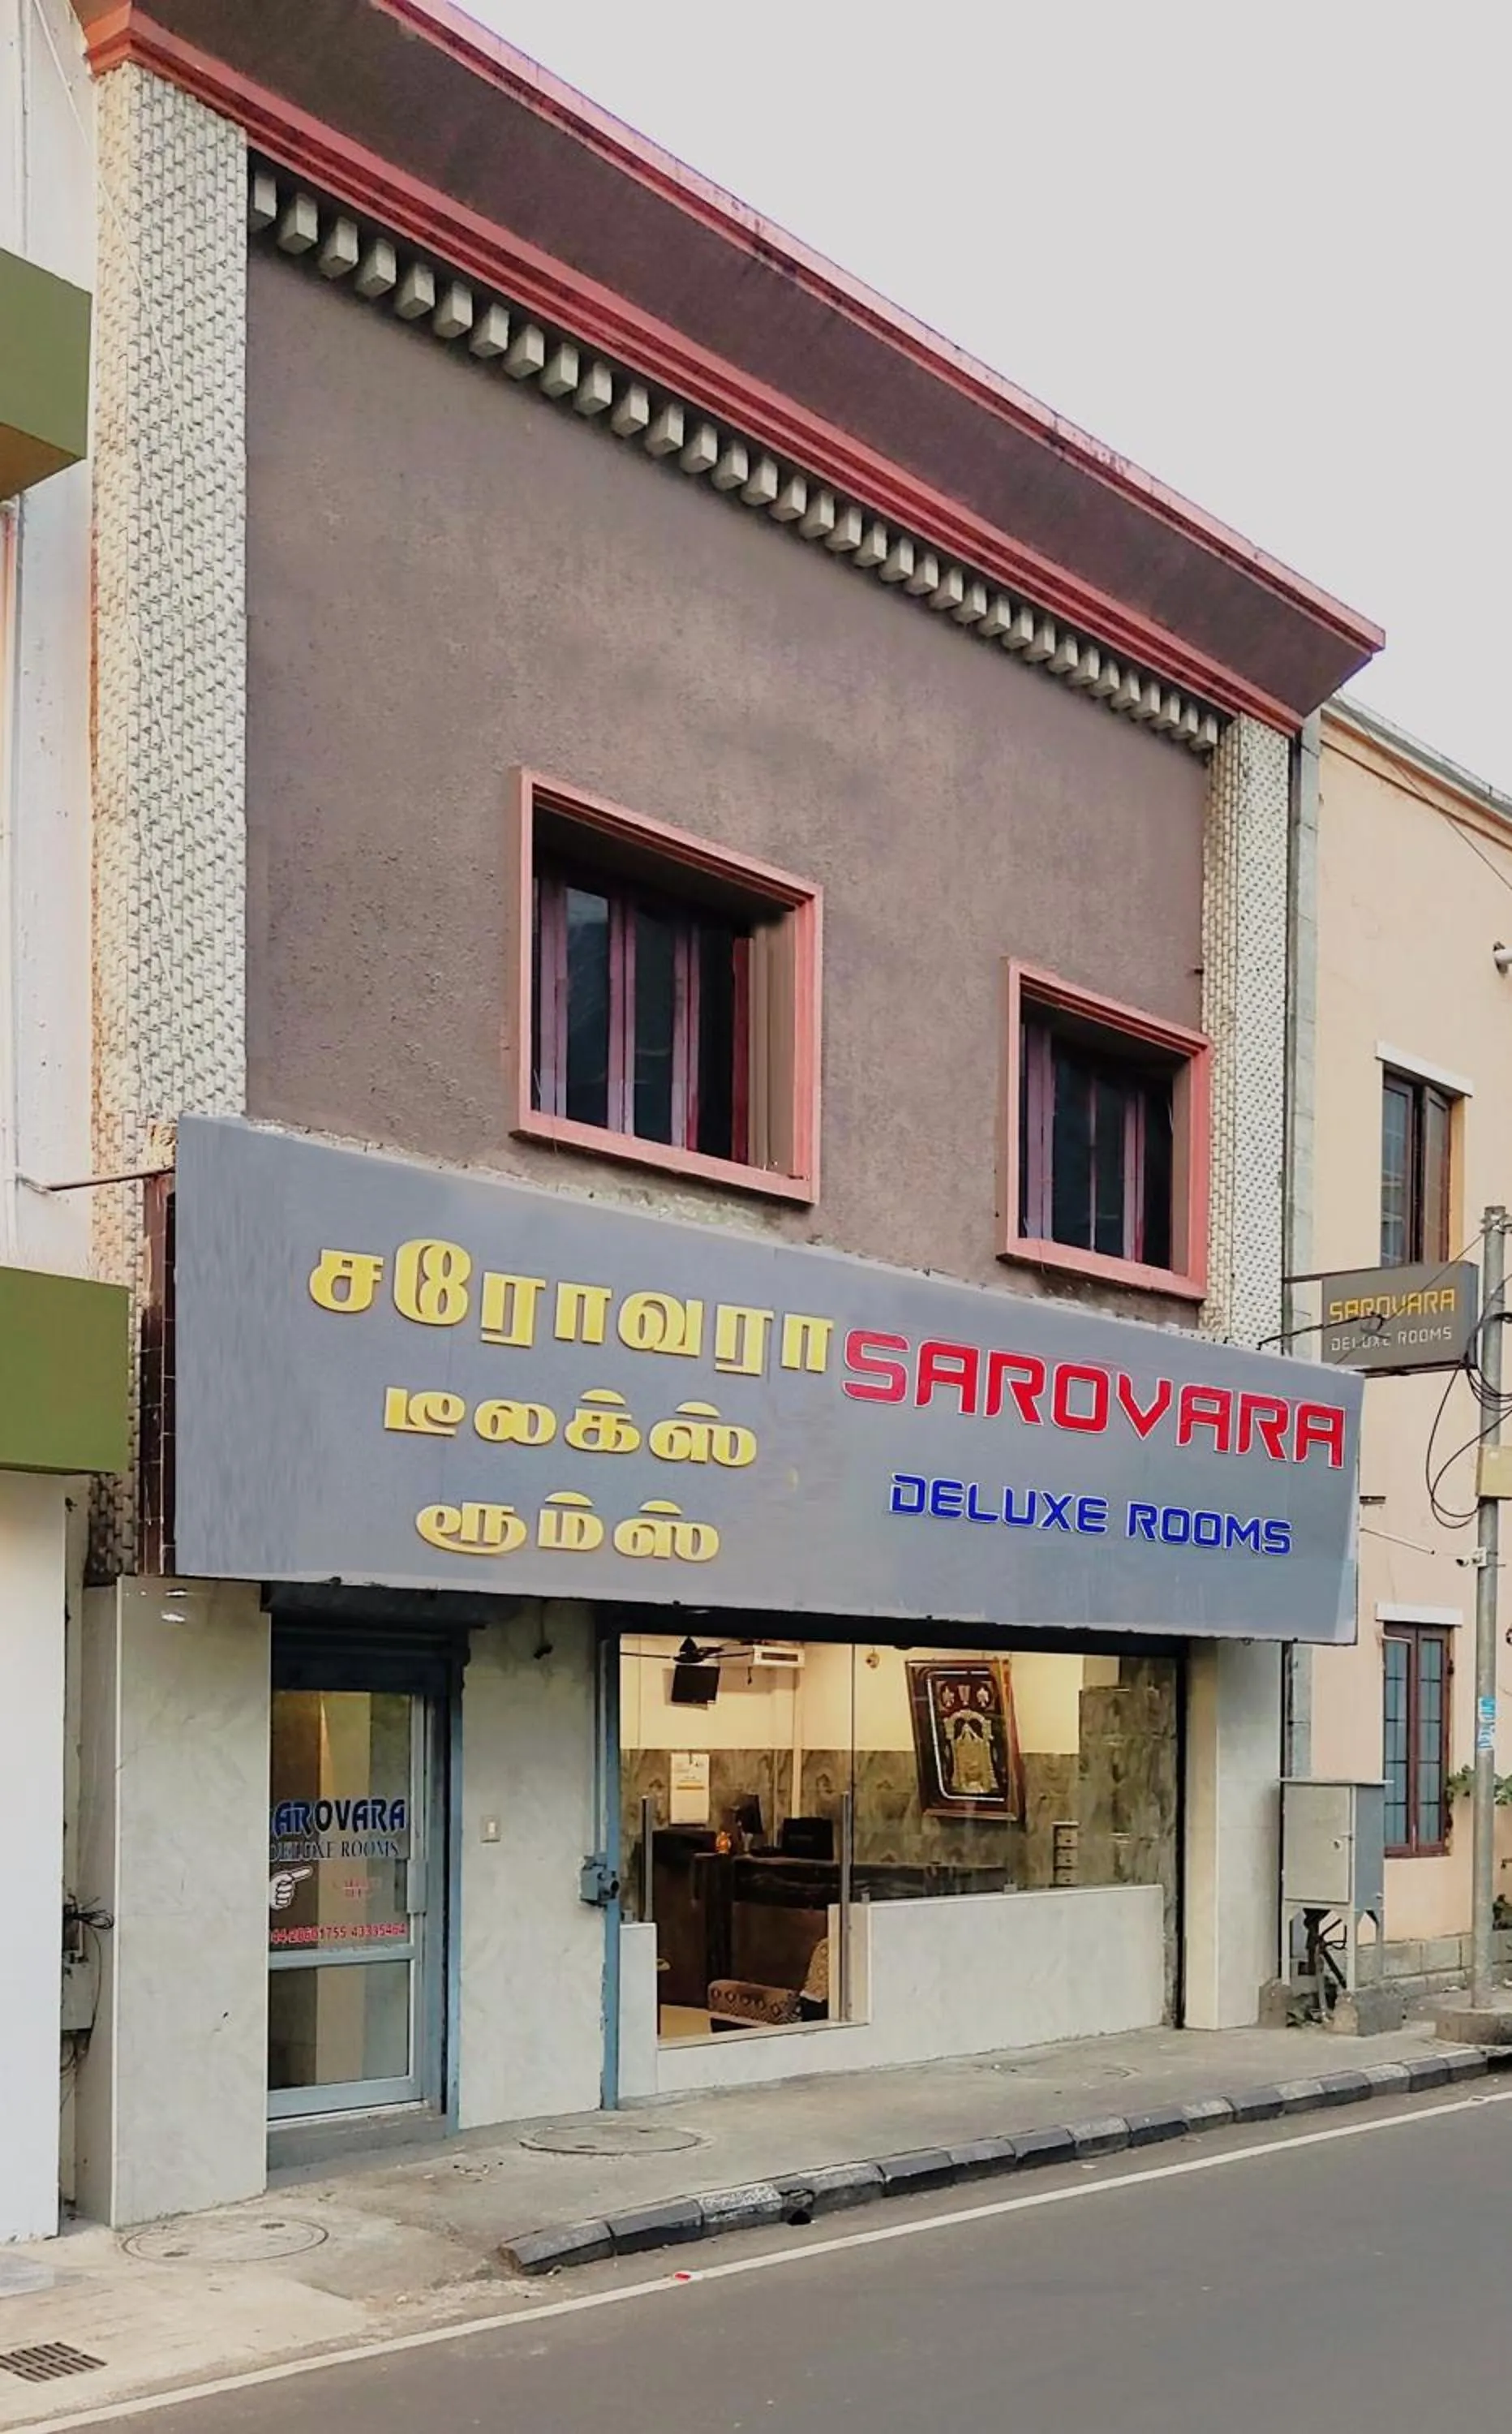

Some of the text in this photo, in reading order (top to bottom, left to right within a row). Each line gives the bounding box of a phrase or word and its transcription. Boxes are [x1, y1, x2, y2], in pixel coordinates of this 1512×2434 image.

[307, 1238, 834, 1377] சரோவரா
[1330, 1288, 1455, 1323] SAROVARA
[1398, 1327, 1452, 1344] ROOMS
[384, 1387, 758, 1468] டீலக்ஸ்
[842, 1327, 1346, 1470] SAROVARA
[415, 1490, 721, 1563] ரூம்ஸ்
[890, 1472, 1293, 1555] DELUXE ROOMS
[270, 1798, 406, 1835] AROVARA
[341, 1839, 401, 1859] ROOMS
